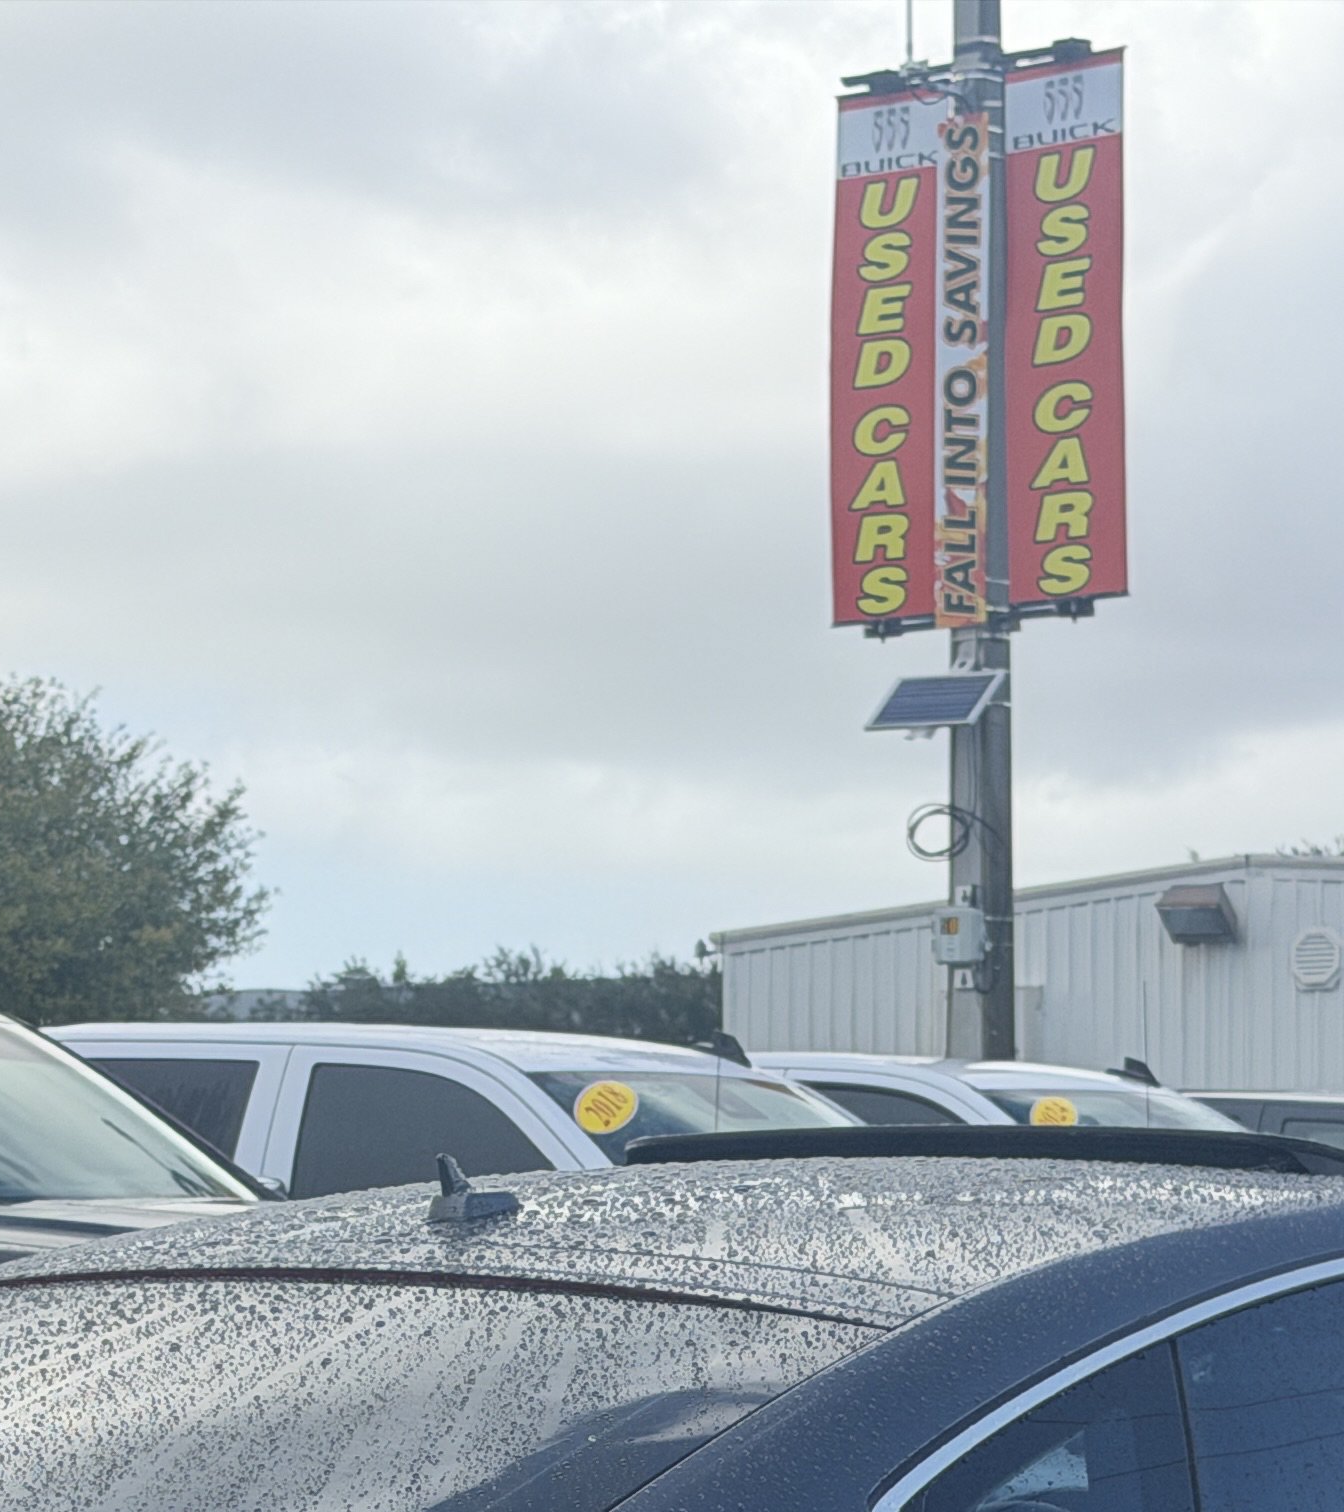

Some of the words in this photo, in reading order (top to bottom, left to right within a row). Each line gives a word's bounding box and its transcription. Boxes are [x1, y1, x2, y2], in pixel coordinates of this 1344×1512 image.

[841, 149, 939, 178] BUICK
[1011, 118, 1117, 151] BUICK
[854, 174, 921, 390] USED
[942, 125, 983, 346] SAVINGS
[1031, 143, 1097, 368] USED
[848, 403, 912, 616] CARS
[942, 367, 979, 487] INTO
[1028, 379, 1095, 597] CARS
[942, 506, 978, 616] FALL
[584, 1085, 629, 1128] 2018
